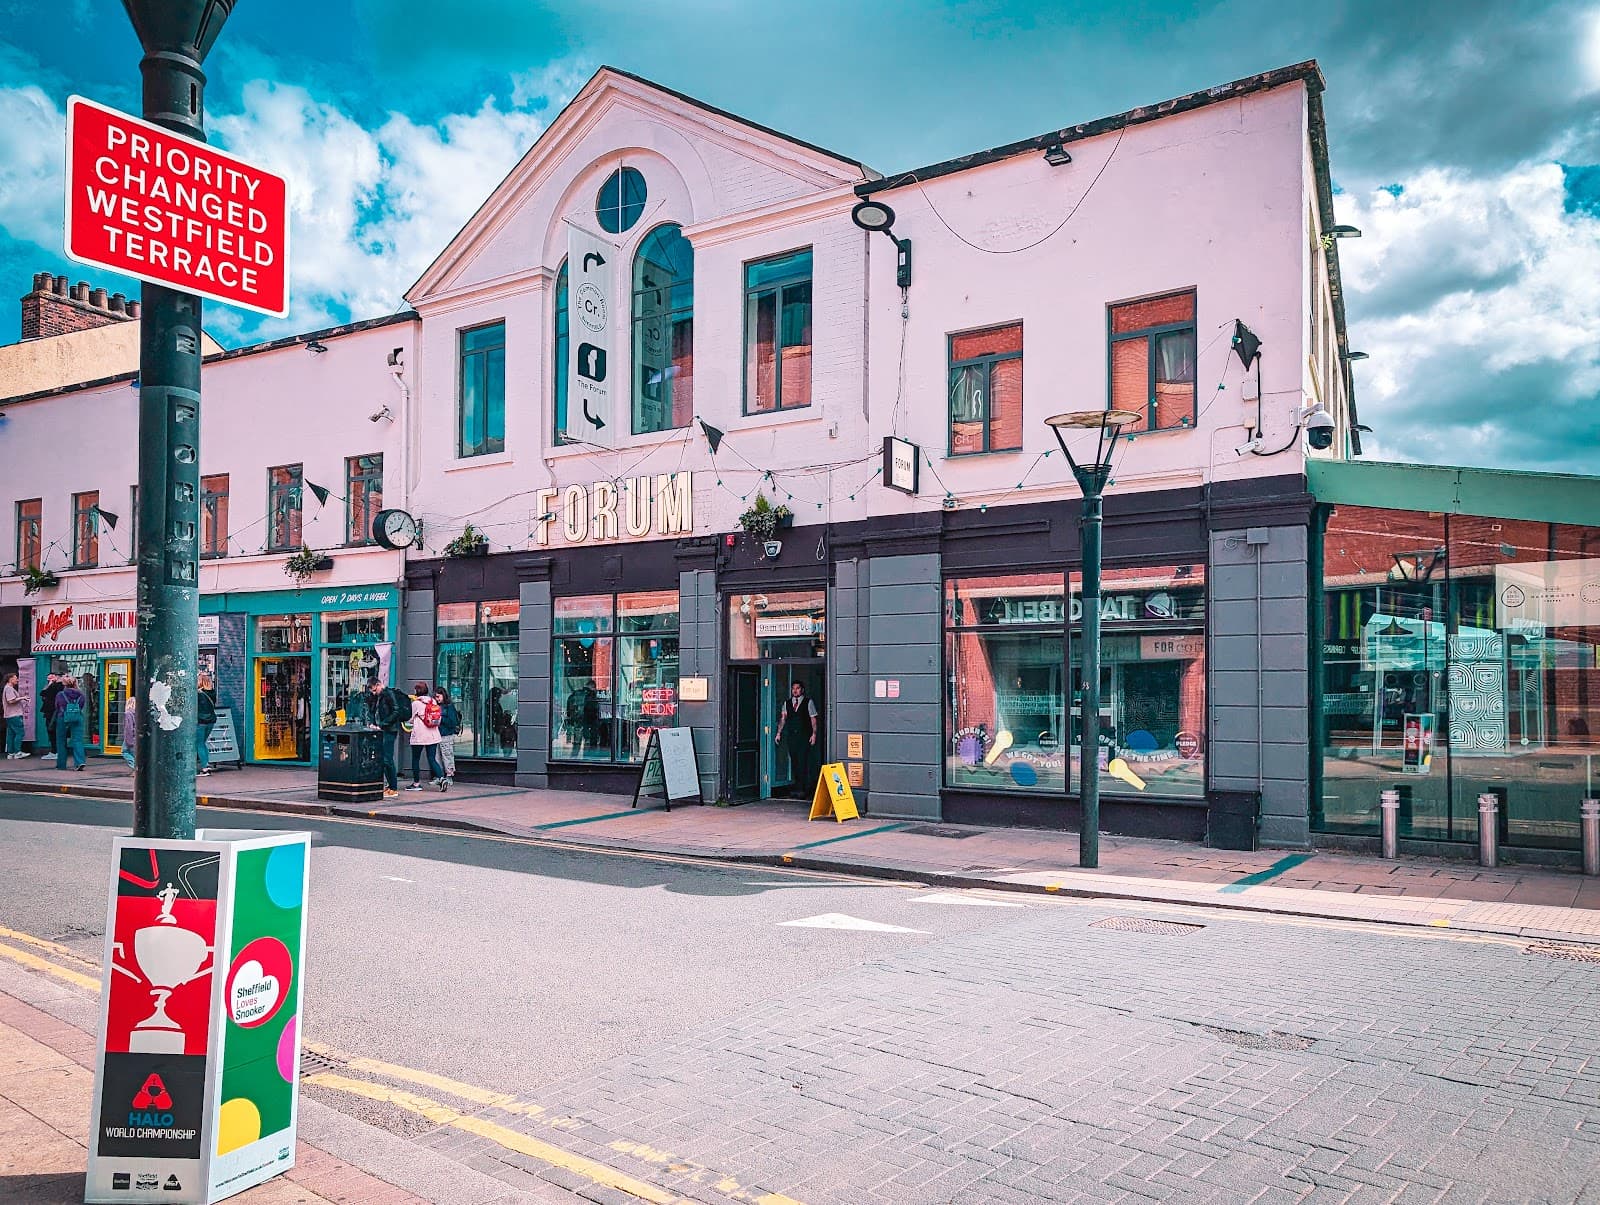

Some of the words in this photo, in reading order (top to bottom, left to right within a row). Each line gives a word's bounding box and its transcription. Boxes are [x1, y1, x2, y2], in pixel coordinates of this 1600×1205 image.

[107, 124, 260, 201] PRIORITY
[95, 156, 267, 234] CHANGED
[86, 185, 274, 267] WESTFIELD
[103, 225, 258, 294] TERRACE
[577, 379, 589, 390] The
[536, 470, 694, 546] FORUM
[321, 595, 338, 604] OPEN
[340, 593, 346, 604] 7
[347, 593, 362, 602] DAYS
[363, 593, 369, 601] A
[36, 605, 74, 644] Vulgar
[78, 612, 106, 631] VINTAGE
[109, 611, 126, 629] MINI
[1154, 641, 1174, 653] FOR
[642, 689, 674, 701] KEEP
[641, 703, 675, 715] NEON
[237, 979, 272, 999] Sheffield
[236, 996, 258, 1010] Loves
[235, 1004, 266, 1021] Snooker
[128, 1111, 175, 1127] HALO
[106, 1127, 135, 1138] WORLD
[136, 1127, 196, 1140] CHAMPIONSHIP
